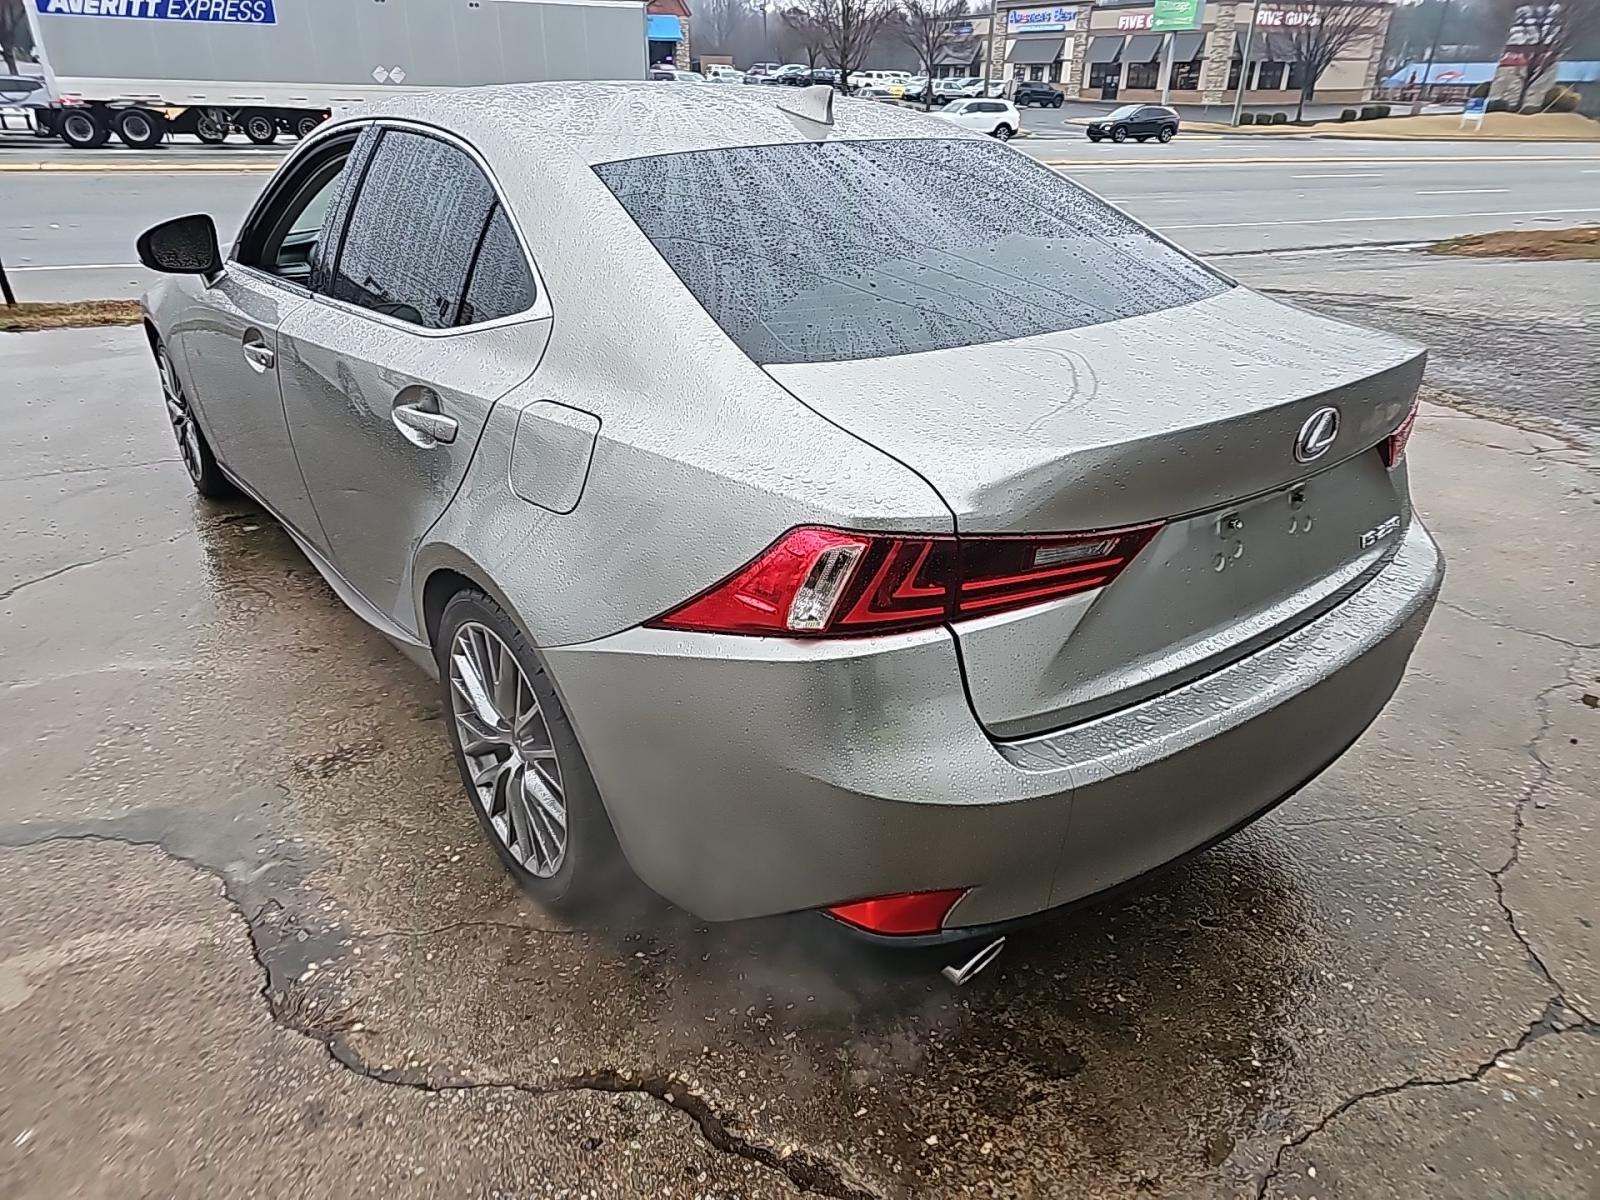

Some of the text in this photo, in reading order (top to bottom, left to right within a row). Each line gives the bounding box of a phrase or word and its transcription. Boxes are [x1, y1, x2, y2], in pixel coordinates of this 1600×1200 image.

[46, 0, 267, 21] AVERITT EXPRESS
[1255, 10, 1320, 27] FIVE GUYS
[1118, 15, 1145, 30] FIVE
